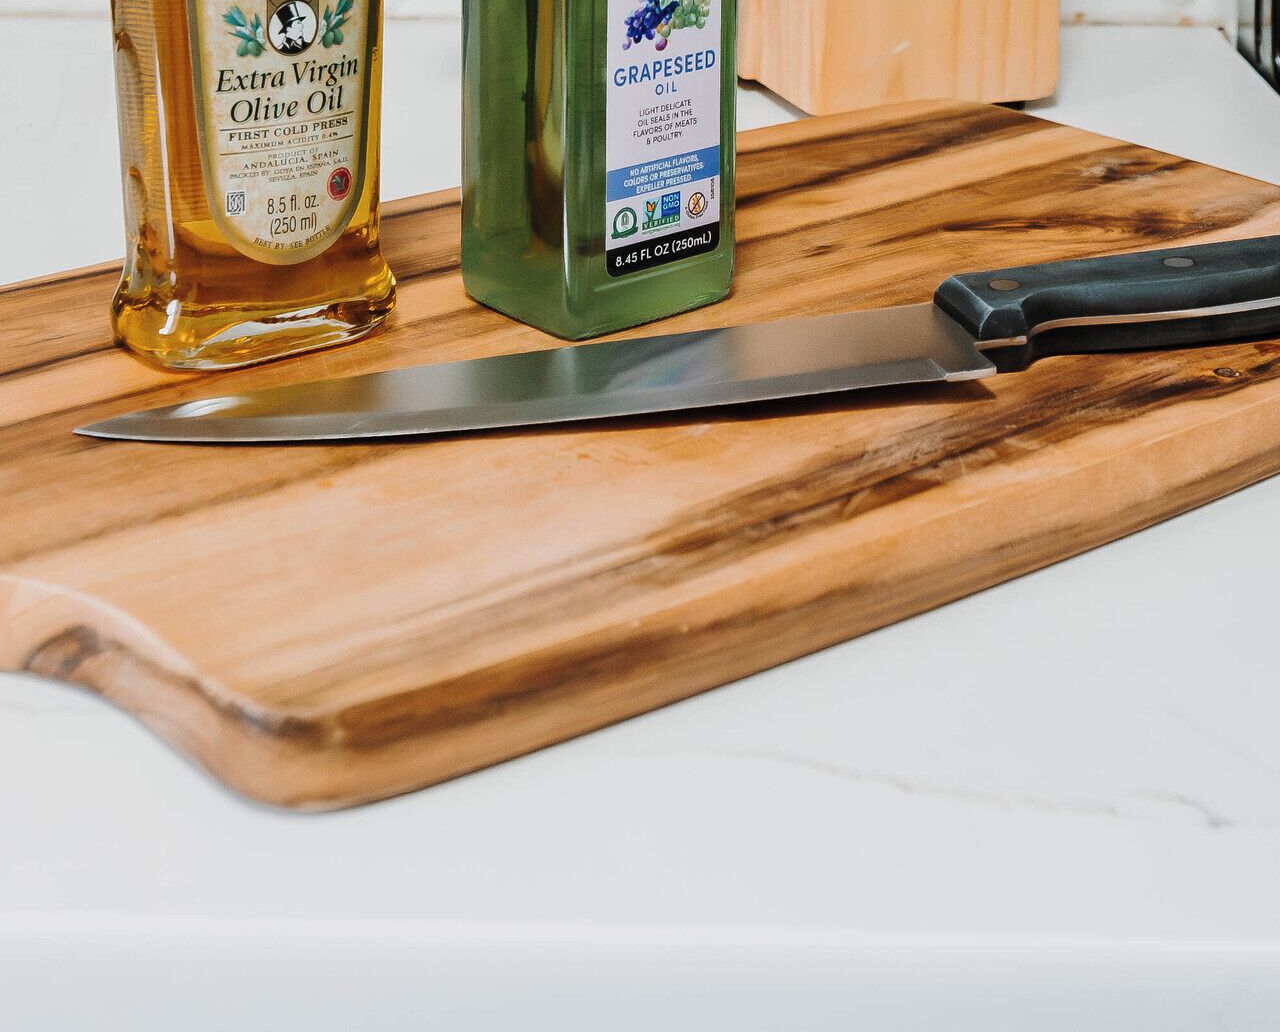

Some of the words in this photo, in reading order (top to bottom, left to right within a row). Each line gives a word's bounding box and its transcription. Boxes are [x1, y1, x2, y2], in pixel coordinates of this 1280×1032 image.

[215, 69, 287, 93] Extra
[291, 54, 358, 87] Virgin
[613, 49, 716, 87] GRAPESEED
[655, 81, 677, 95] OIL
[230, 97, 299, 124] Olive
[306, 85, 344, 114] Oil
[639, 106, 659, 117] LIGHT
[660, 98, 692, 113] DELICATE
[637, 119, 648, 128] OIL
[650, 113, 671, 125] SEALS
[671, 111, 679, 120] IN
[680, 108, 693, 118] THE
[228, 130, 270, 142] FIRST
[273, 124, 308, 137] COLD
[312, 116, 348, 132] PRESS
[633, 125, 663, 138] FLAVORS
[664, 122, 674, 132] OF
[675, 117, 698, 129] MEATS
[241, 140, 284, 150] MAXIMUM
[287, 134, 320, 145] ACIDITY
[267, 148, 307, 160] PRODUCT
[308, 147, 320, 155] OF
[312, 149, 339, 161] SPAIN
[273, 167, 294, 176] GOYA
[629, 168, 640, 177] NO
[640, 161, 672, 175] ARTIFICIAL
[623, 174, 649, 188] COLORS
[649, 172, 659, 181] OR
[636, 180, 665, 194] EXPELLER
[267, 196, 287, 215] 8.5
[289, 194, 301, 212] fl.
[304, 194, 320, 209] oz.
[662, 200, 680, 211] GMO
[663, 193, 679, 204] NON
[270, 215, 297, 239] (250
[300, 211, 318, 232] ml)
[643, 214, 680, 229] VERIFIED
[253, 236, 272, 249] BEST
[289, 240, 304, 250] SEE
[305, 224, 332, 248] BOTTLE
[615, 251, 638, 267] 8.45
[640, 248, 652, 261] FL
[654, 243, 670, 257] OZ
[671, 230, 713, 254] (250mL)
